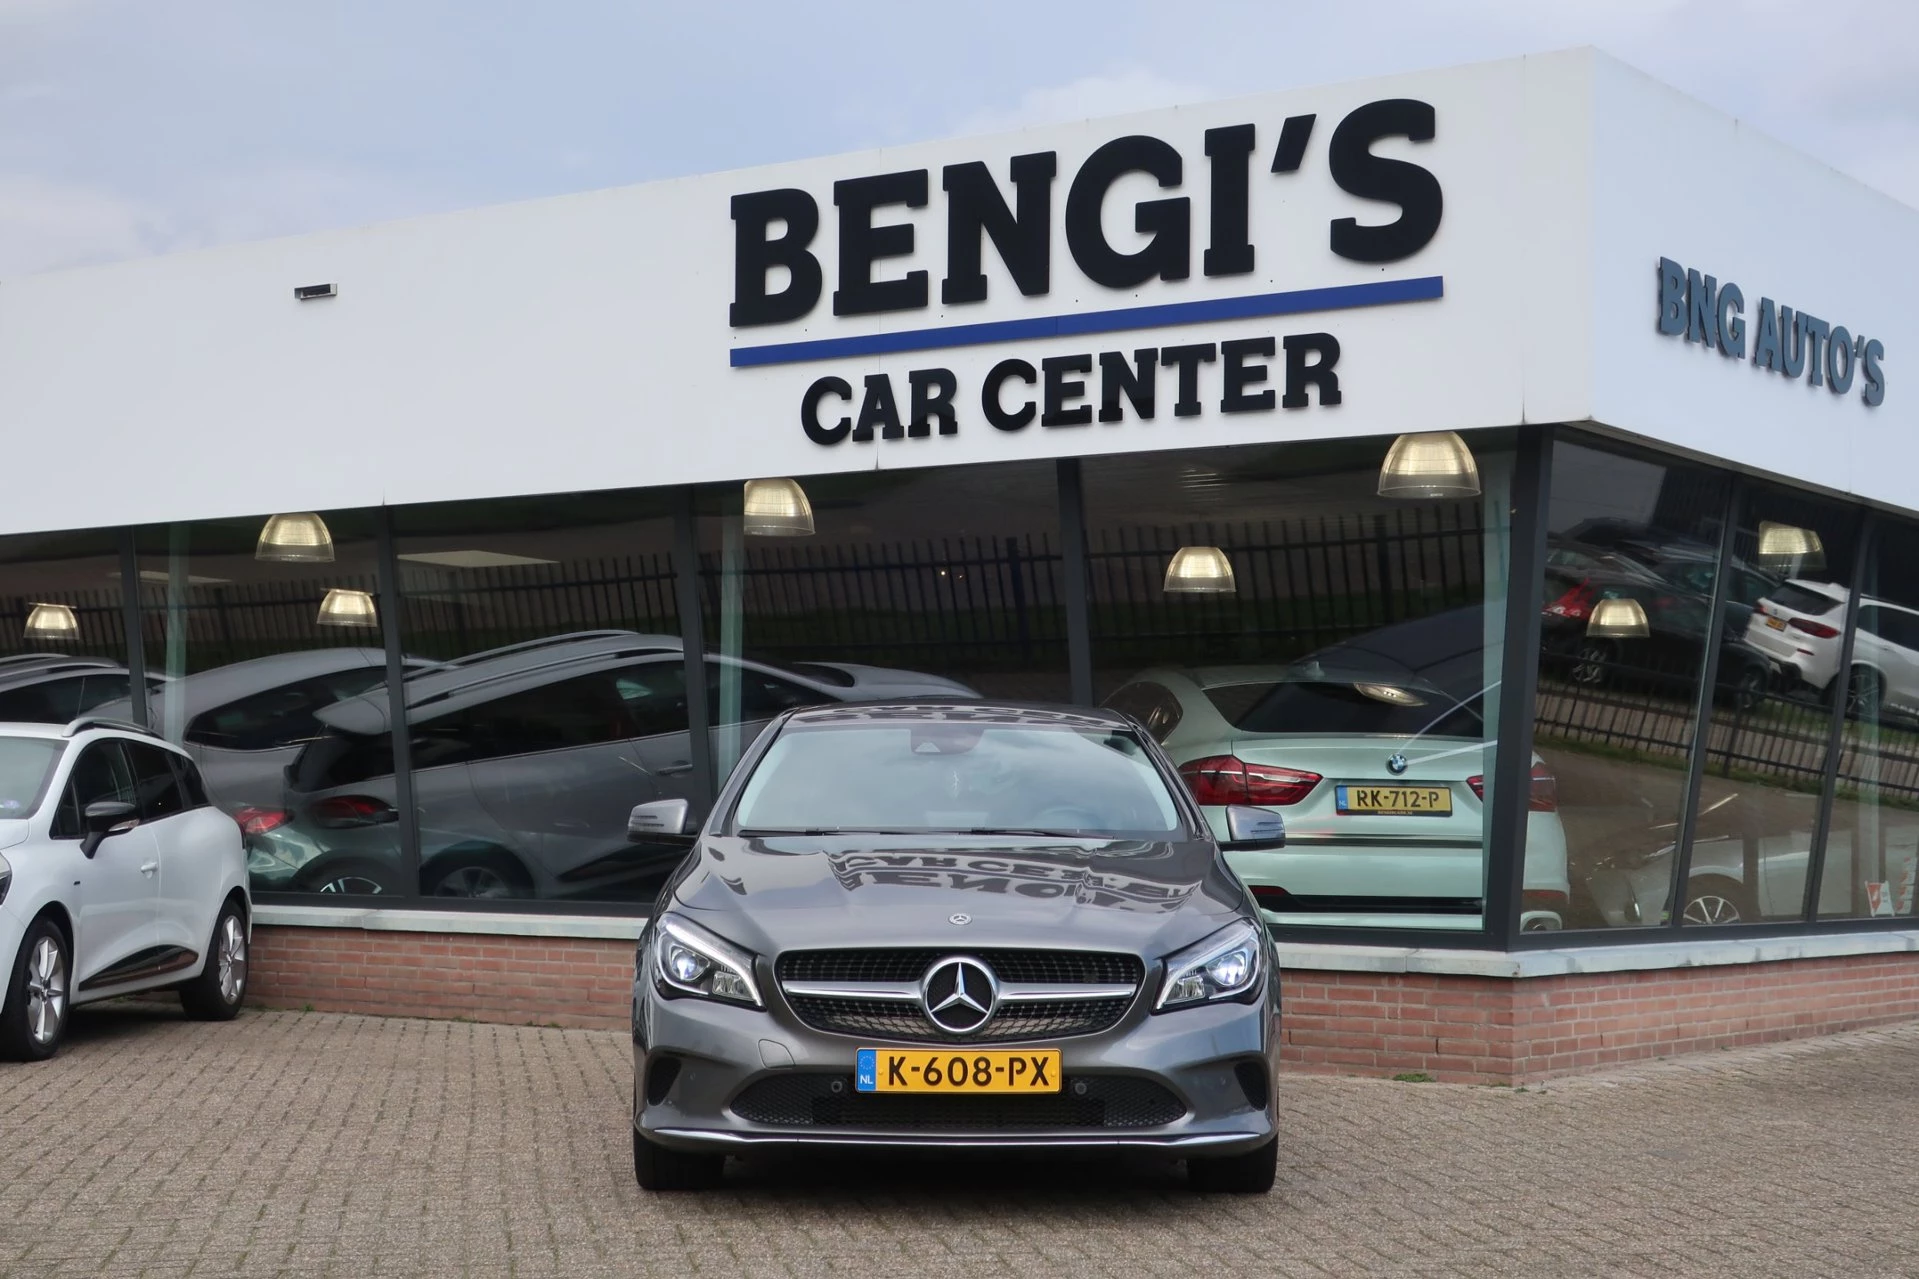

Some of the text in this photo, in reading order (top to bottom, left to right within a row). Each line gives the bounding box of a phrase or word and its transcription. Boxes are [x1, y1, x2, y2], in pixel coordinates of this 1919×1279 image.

[729, 98, 1443, 328] BENGI'S
[1657, 256, 1885, 407] BNG AUTO'S
[801, 332, 1342, 447] CAR CENTER
[1356, 789, 1440, 808] RK-712-P
[859, 1074, 874, 1085] NL
[888, 1056, 1050, 1087] K-608-PX
